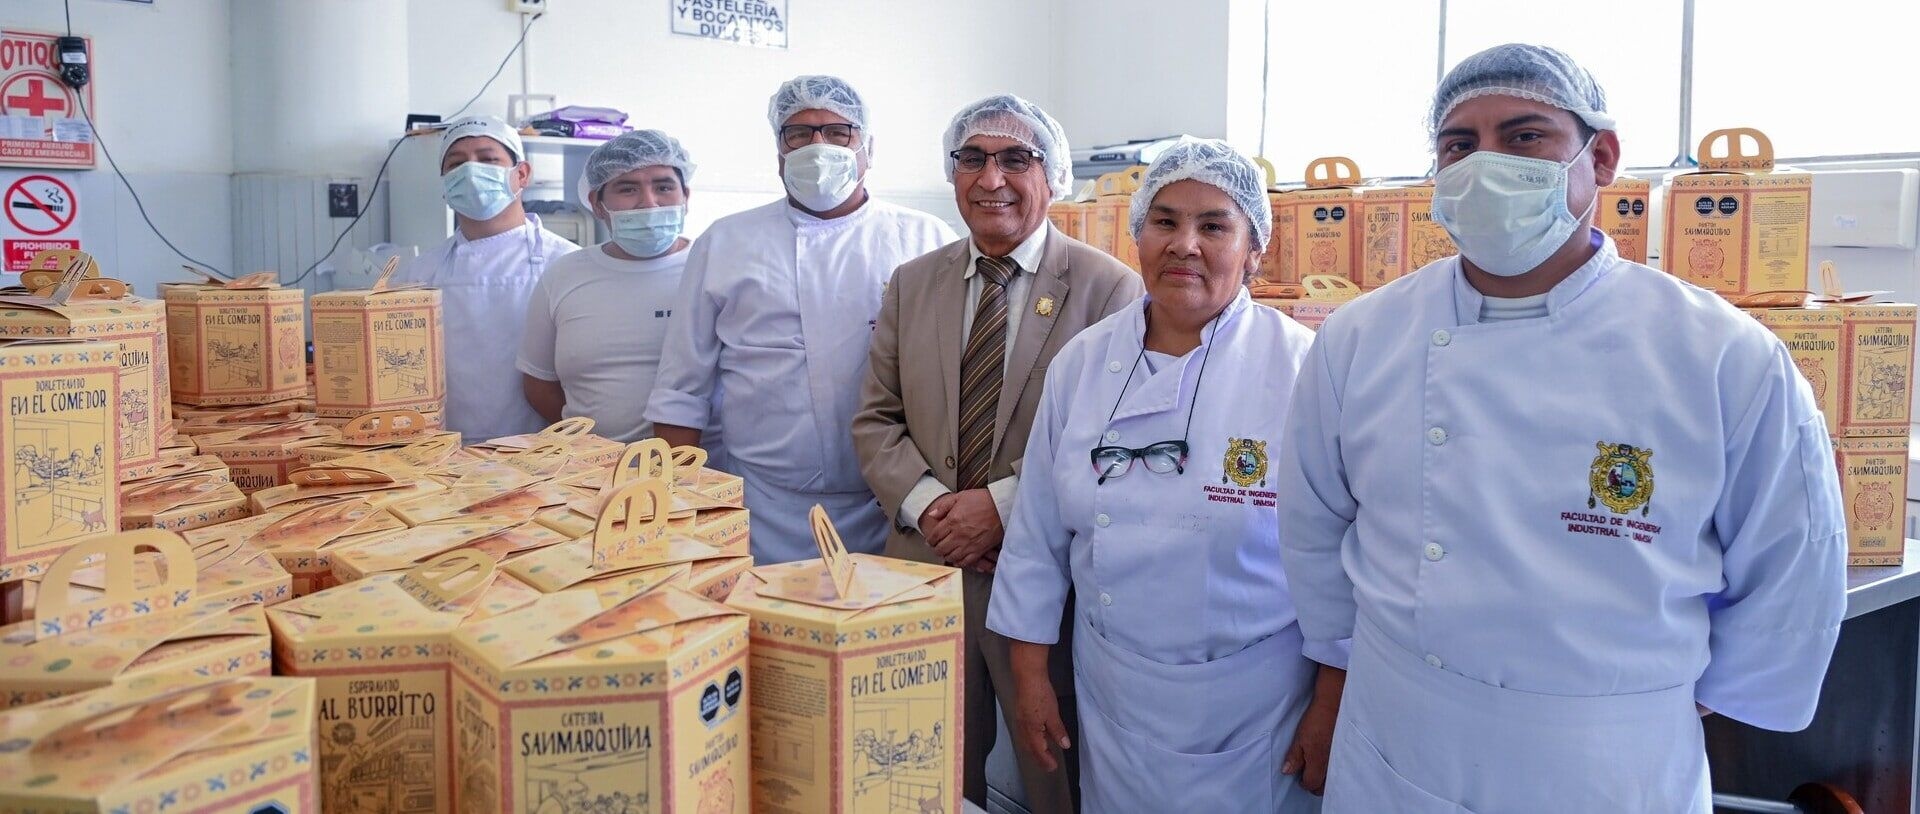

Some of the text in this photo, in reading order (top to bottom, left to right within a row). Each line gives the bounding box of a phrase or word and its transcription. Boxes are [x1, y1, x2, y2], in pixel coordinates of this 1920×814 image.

[678, 6, 687, 18] Y
[700, 23, 761, 45] DUC
[2, 141, 40, 149] PRIMEROS
[35, 149, 85, 158] EMERGENCIAS
[13, 242, 71, 250] PROHIBIDO
[33, 394, 46, 414] EL
[51, 389, 107, 412] COMEDOR
[1204, 485, 1235, 494] FACULTAD
[1208, 494, 1244, 504] INDUSTRIAL
[1561, 512, 1606, 524] FACULTAD
[1610, 517, 1622, 526] DE
[1568, 523, 1620, 537] INDUSTRIAL
[872, 671, 886, 693] EL
[891, 660, 948, 690] COMEDOR
[319, 698, 340, 720] AL
